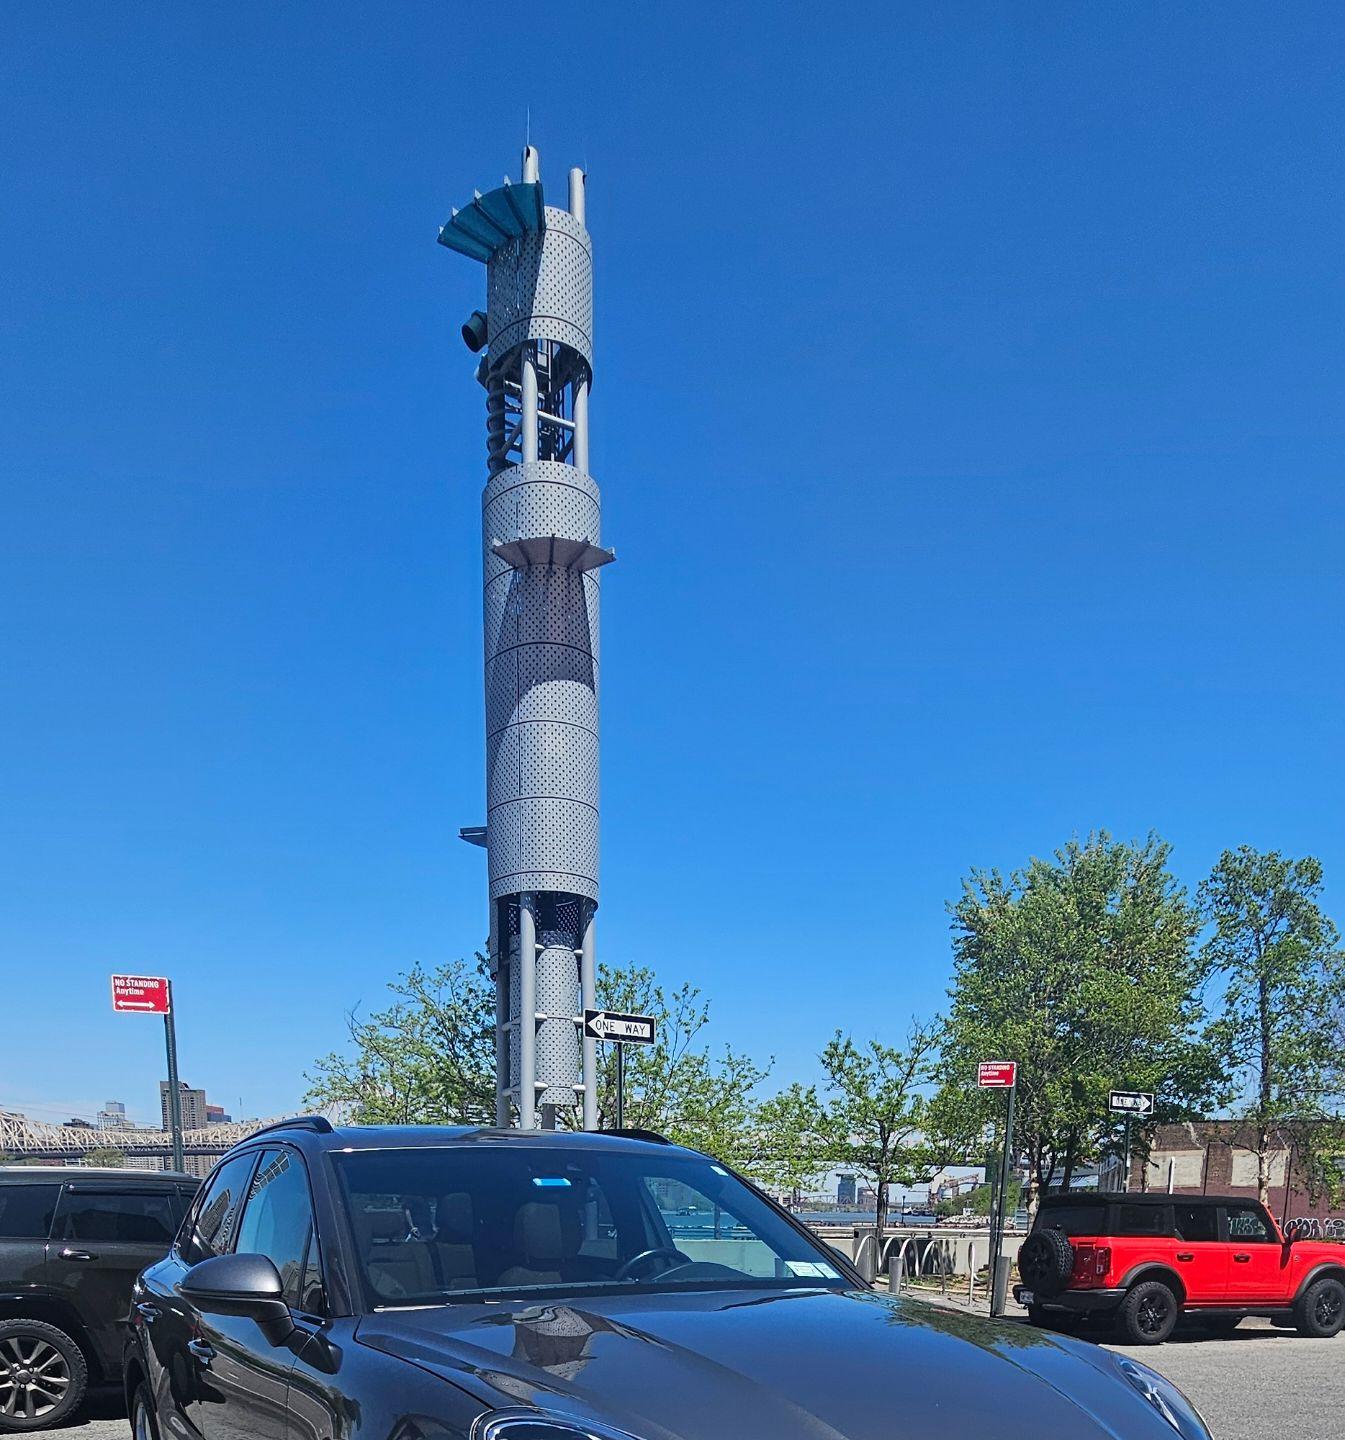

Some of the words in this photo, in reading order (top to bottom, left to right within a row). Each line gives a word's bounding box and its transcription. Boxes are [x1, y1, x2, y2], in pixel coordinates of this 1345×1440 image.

[115, 979, 125, 987] NO
[126, 980, 159, 989] STANDING
[116, 987, 145, 996] Anytime
[596, 1020, 615, 1032] ONE
[625, 1023, 646, 1035] WAY
